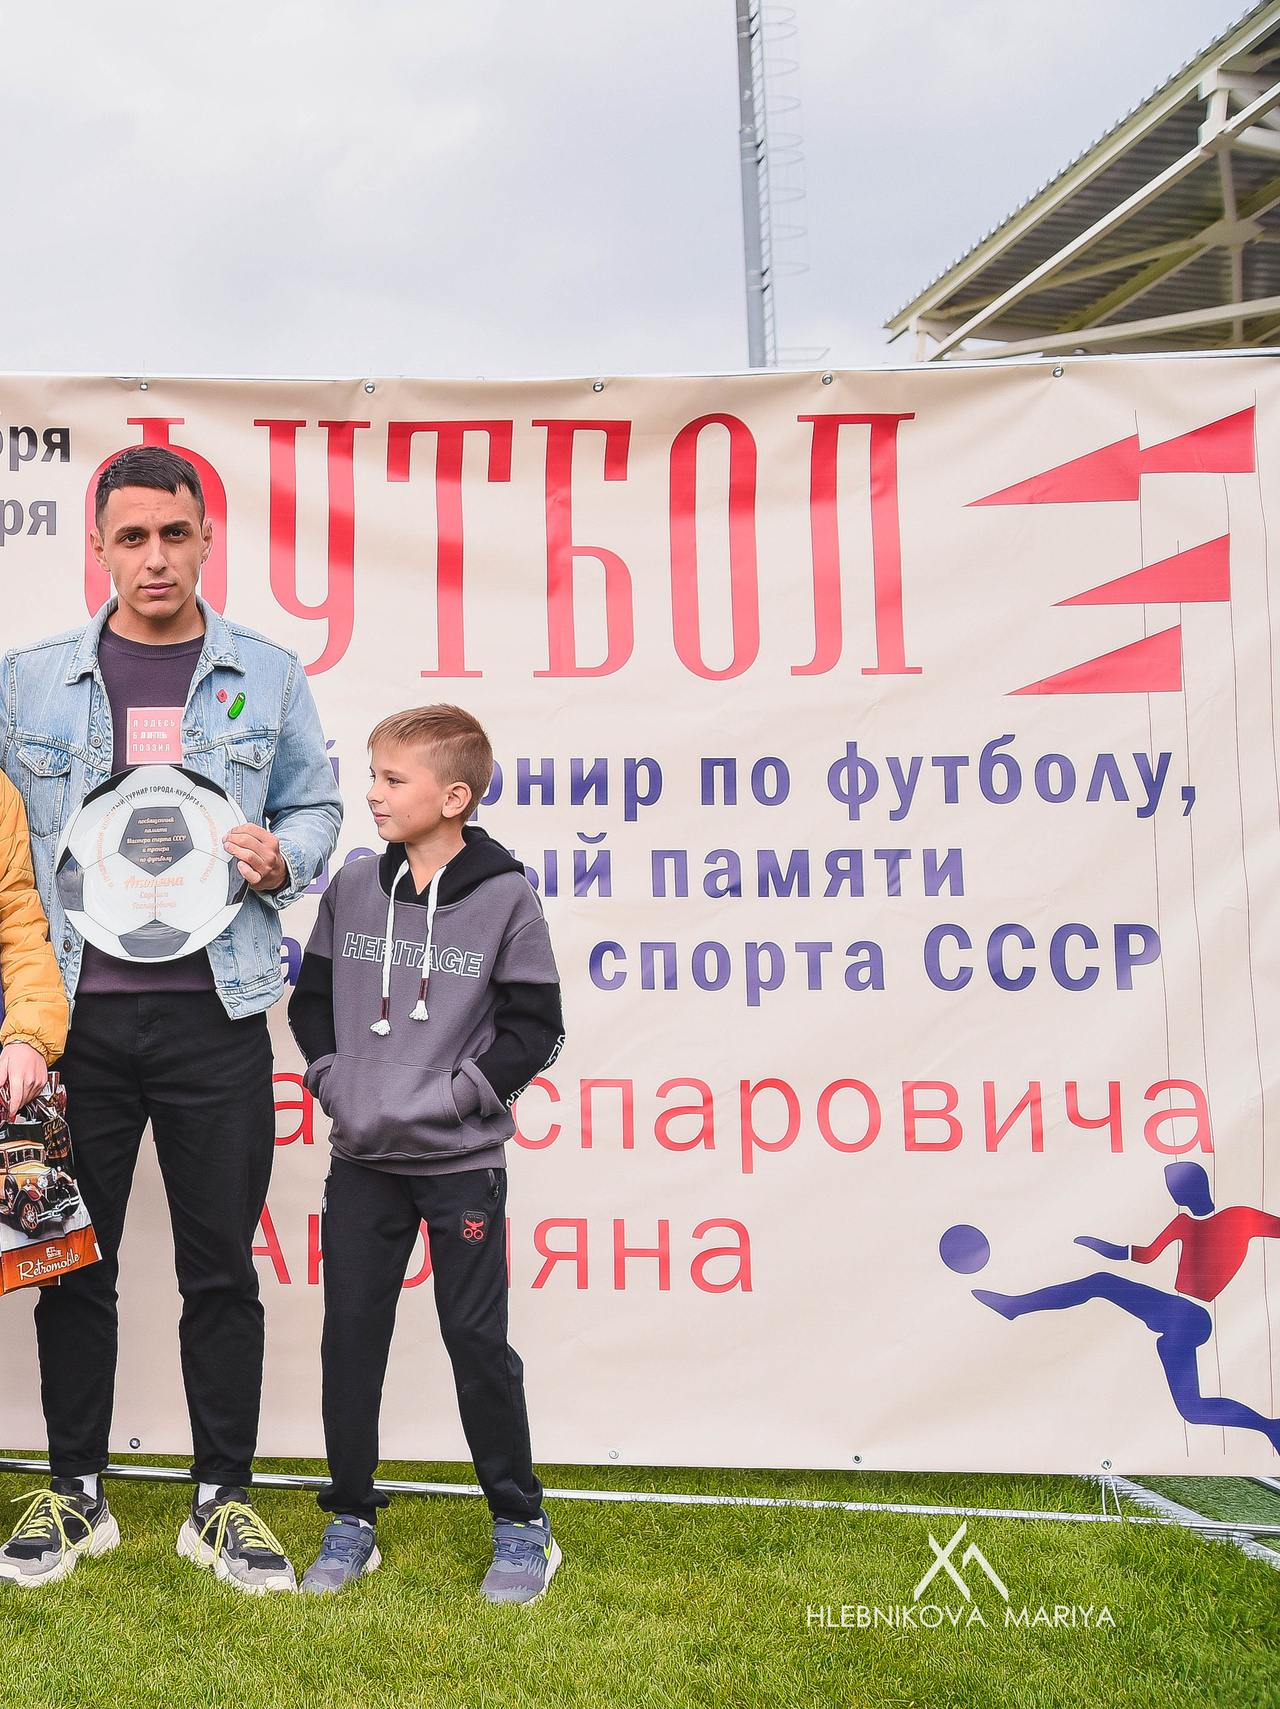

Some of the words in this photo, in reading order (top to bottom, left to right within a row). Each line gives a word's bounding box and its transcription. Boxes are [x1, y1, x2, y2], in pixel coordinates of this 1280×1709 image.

[133, 719, 139, 728] Я
[124, 786, 149, 801] ТУРНИР
[701, 756, 791, 806] по
[826, 734, 1198, 822] футболу,
[124, 875, 184, 890] Акопяна
[650, 847, 966, 898] памяти
[342, 932, 485, 979] HERITAGE
[588, 941, 884, 1006] спорта
[923, 923, 1160, 991] СССР
[509, 1075, 1215, 1174] спаровича
[16, 1247, 81, 1282] Retromobile
